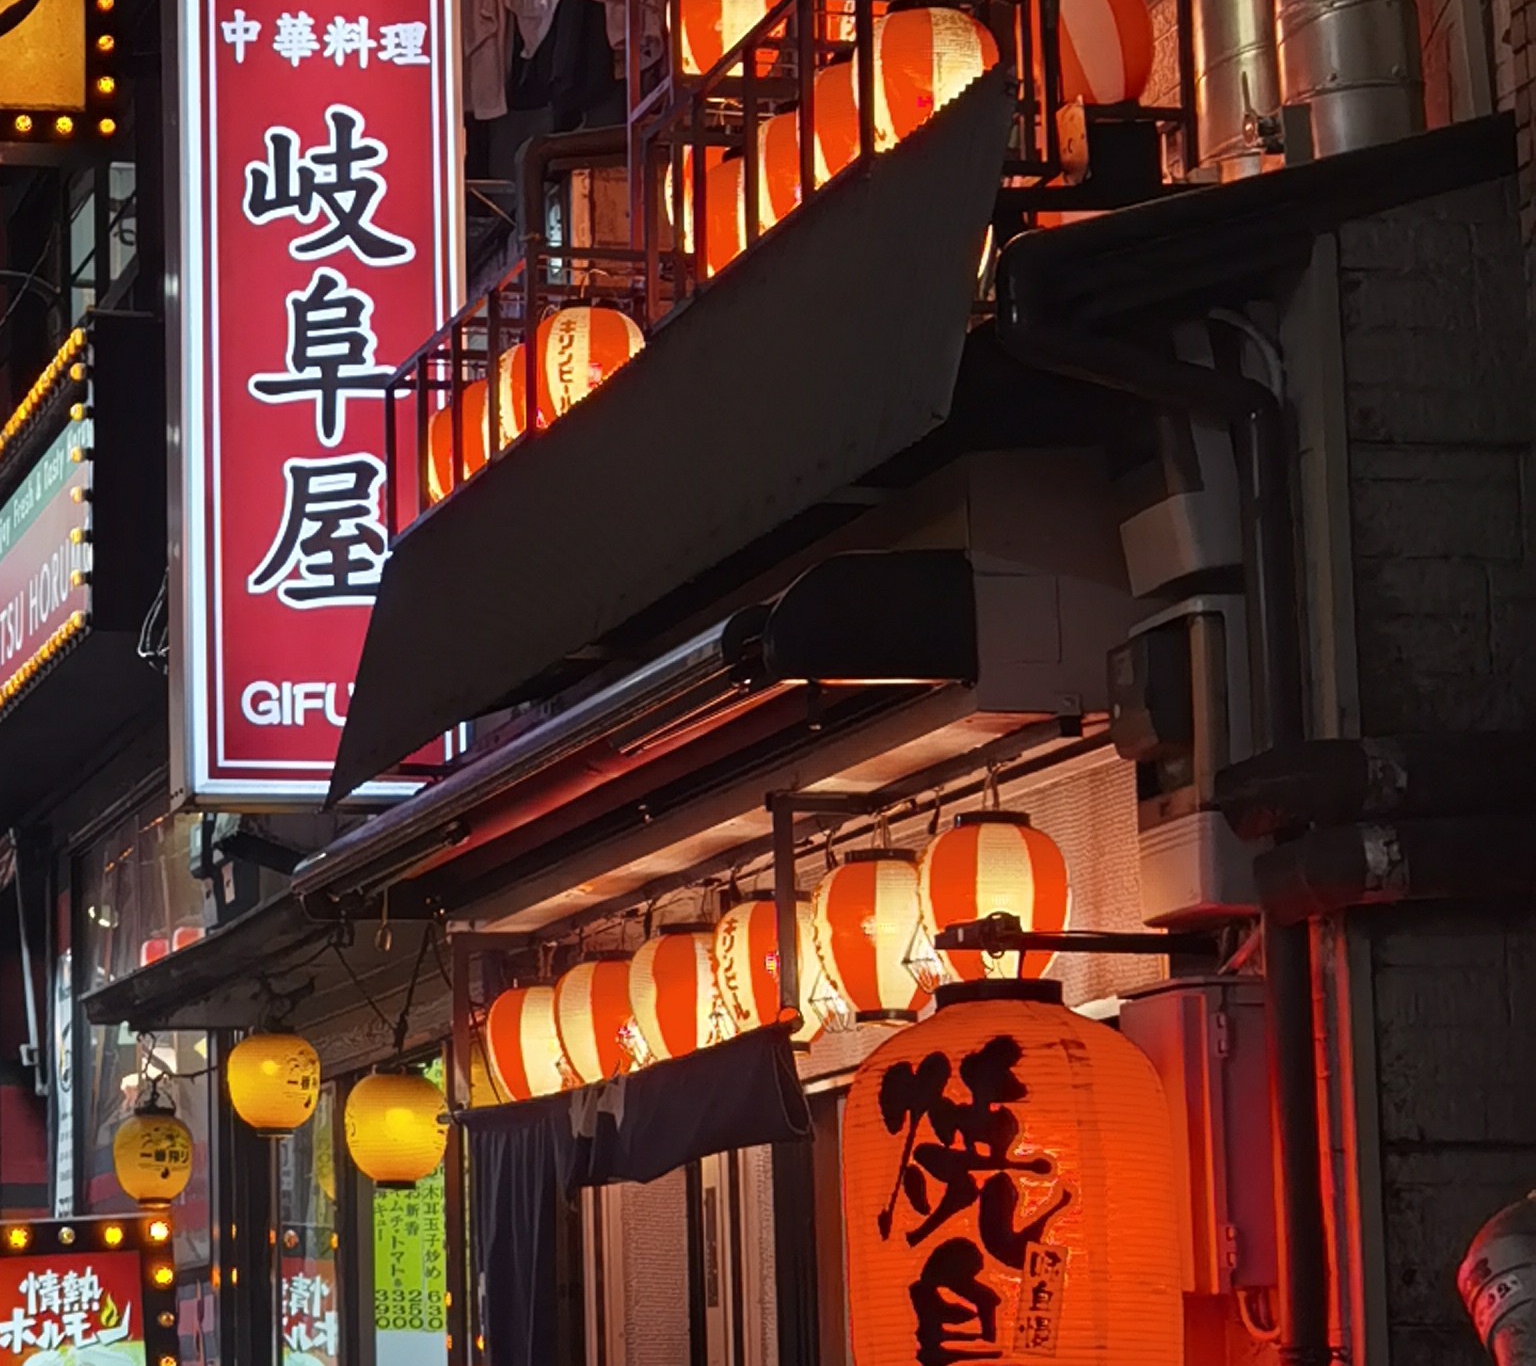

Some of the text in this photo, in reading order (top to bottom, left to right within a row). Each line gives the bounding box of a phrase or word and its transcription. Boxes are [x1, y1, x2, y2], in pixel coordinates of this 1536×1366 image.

[220, 8, 432, 69] 中華料理
[242, 103, 416, 610] 岐阜屋
[722, 916, 752, 1022] キリンビール
[423, 1182, 444, 1330] 木耳玉子炒め 630
[18, 1264, 105, 1316] 情熱
[375, 1288, 390, 1330] 390
[390, 1288, 407, 1330] 330
[407, 1288, 425, 1330] 250
